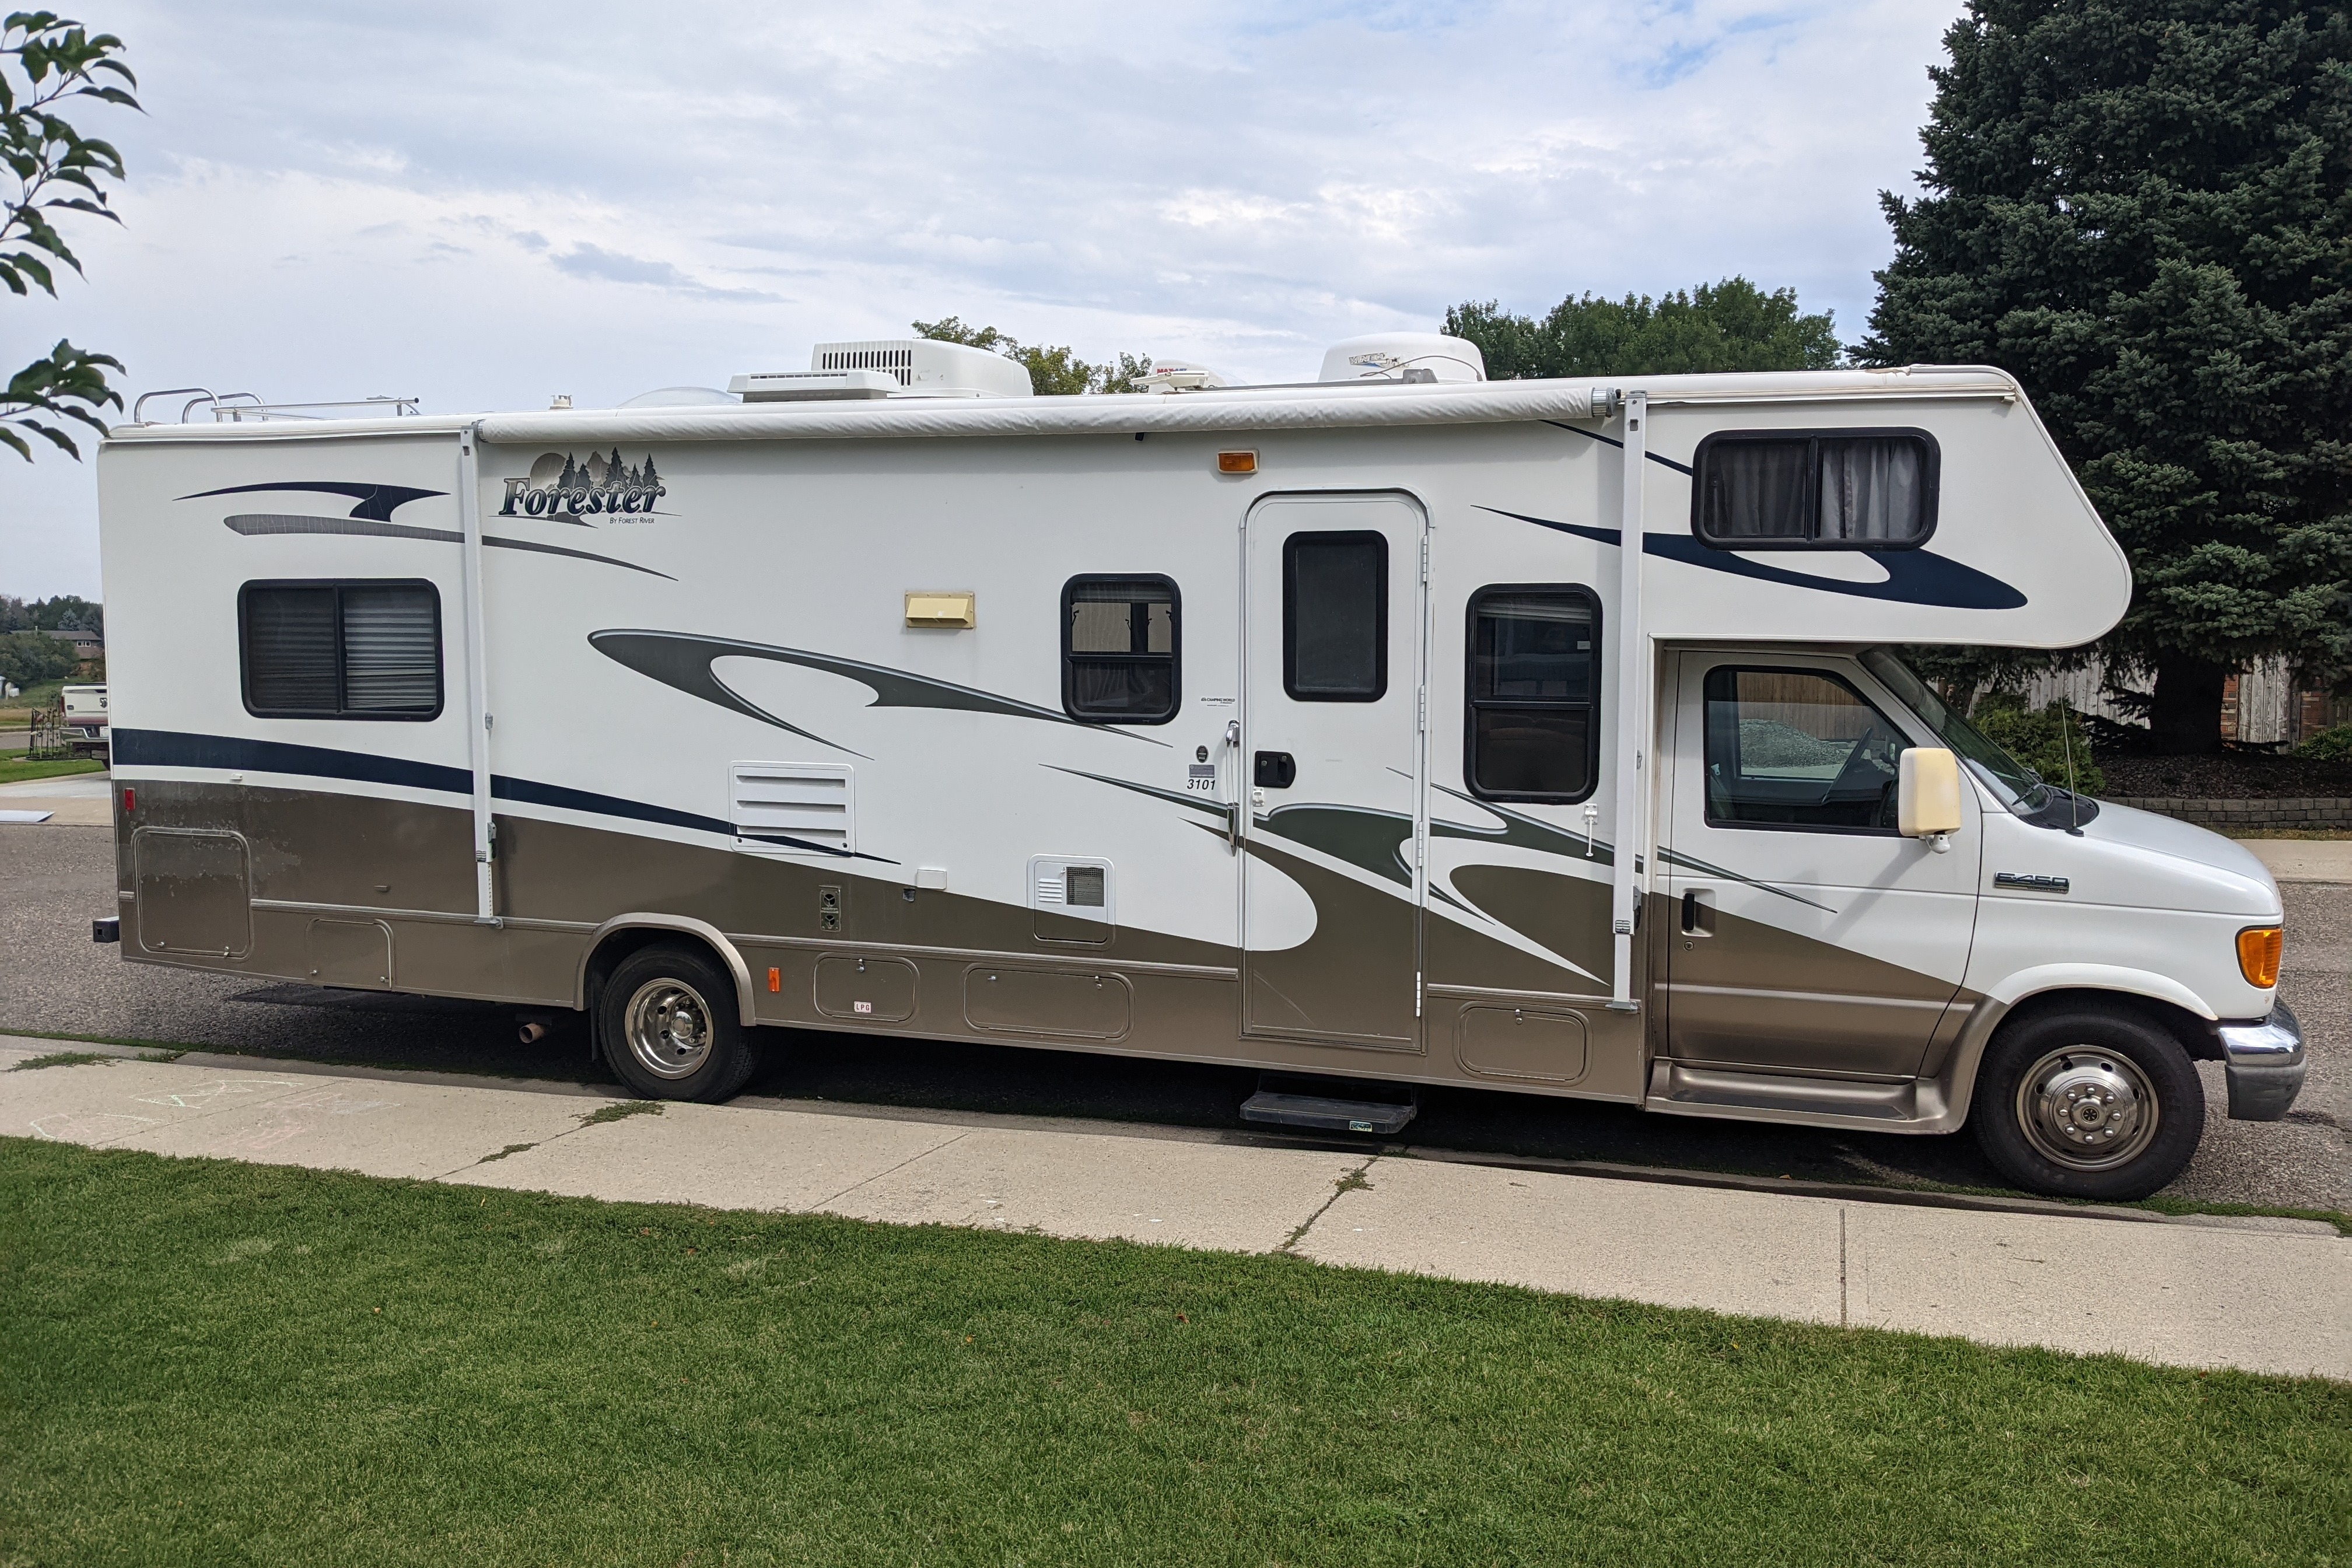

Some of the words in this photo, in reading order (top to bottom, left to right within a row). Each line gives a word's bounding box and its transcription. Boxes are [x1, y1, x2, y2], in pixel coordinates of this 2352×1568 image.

[499, 478, 666, 515] Forester
[1187, 779, 1216, 790] 3101
[1995, 873, 2069, 887] E-450
